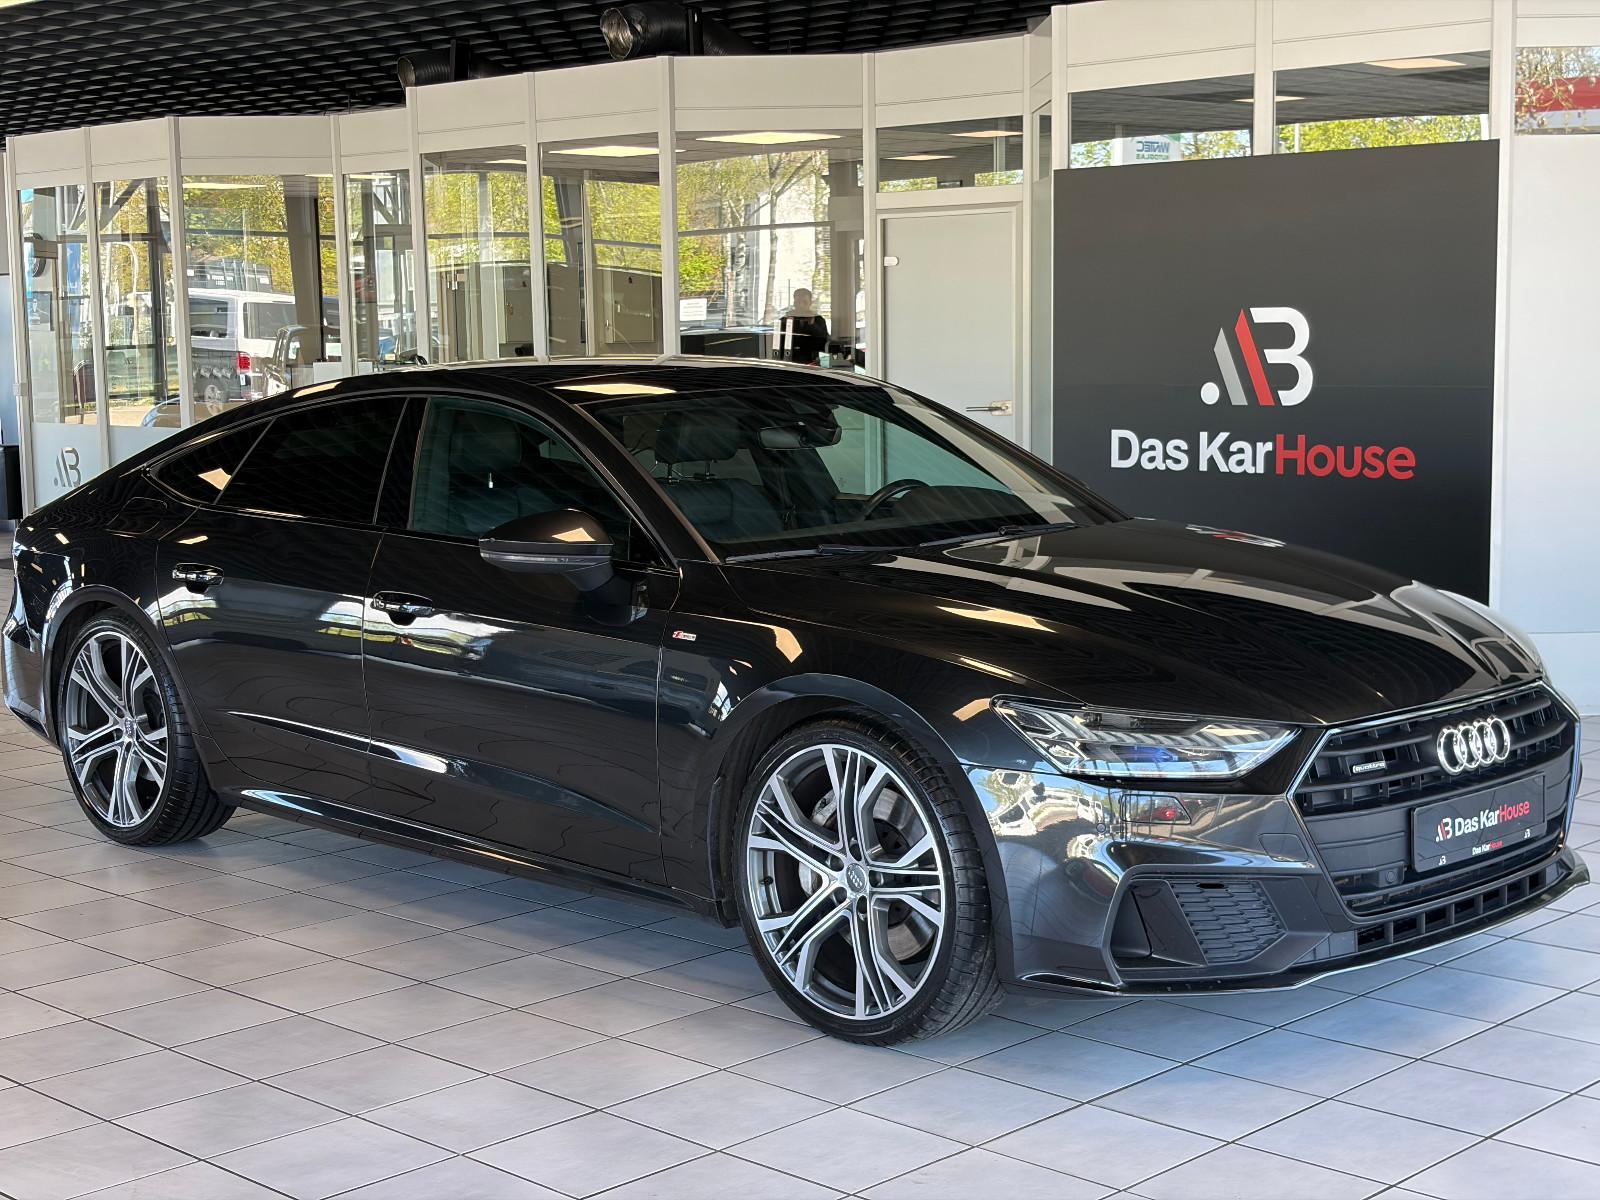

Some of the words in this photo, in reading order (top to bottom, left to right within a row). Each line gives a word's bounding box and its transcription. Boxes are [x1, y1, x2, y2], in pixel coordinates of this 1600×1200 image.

[1110, 429, 1188, 471] Das
[1199, 431, 1416, 480] KarHouse
[1454, 817, 1479, 836] Das
[1480, 801, 1531, 829] KarHouse
[1472, 846, 1482, 855] Das
